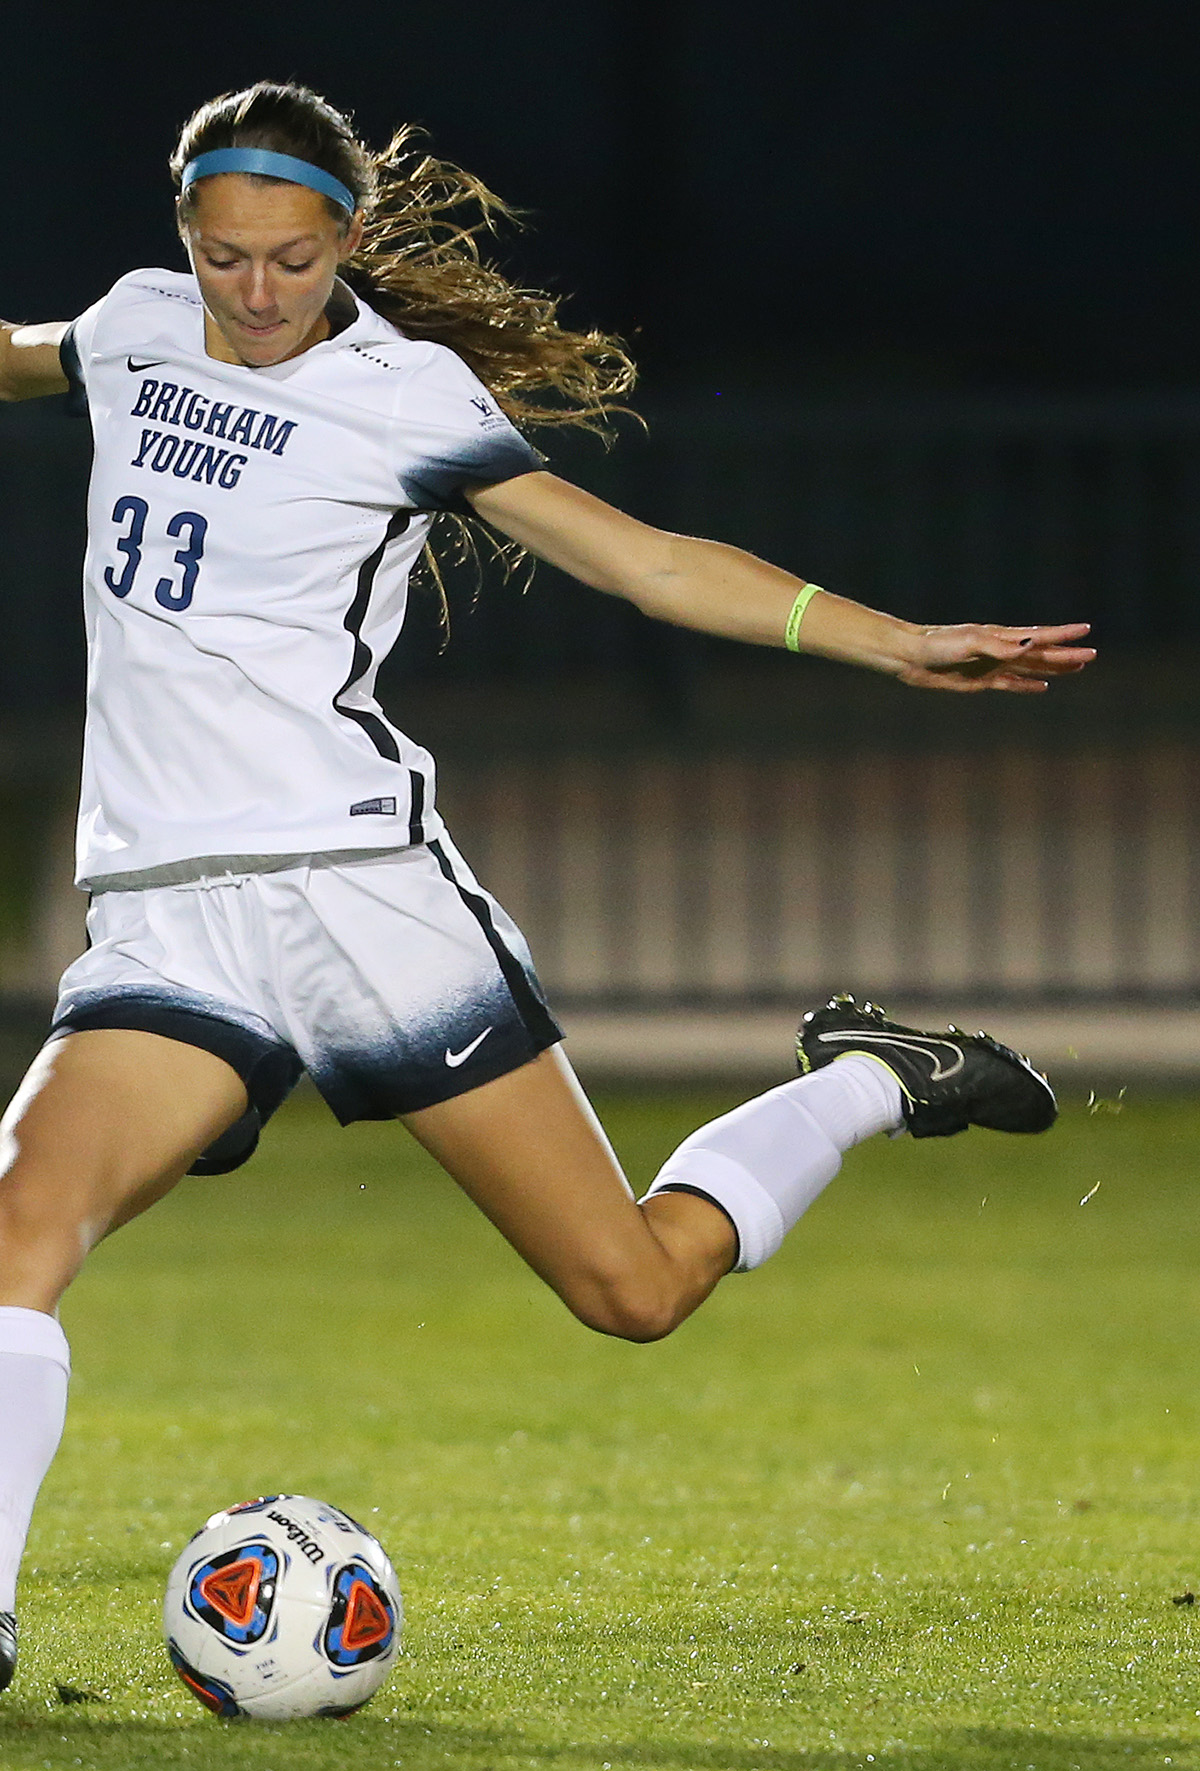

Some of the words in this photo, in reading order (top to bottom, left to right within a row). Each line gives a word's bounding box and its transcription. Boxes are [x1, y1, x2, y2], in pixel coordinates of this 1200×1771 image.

[130, 379, 298, 456] BRIGHAM
[131, 429, 248, 489] YOUNG
[104, 495, 208, 611] 33
[267, 1511, 324, 1564] Wilson
